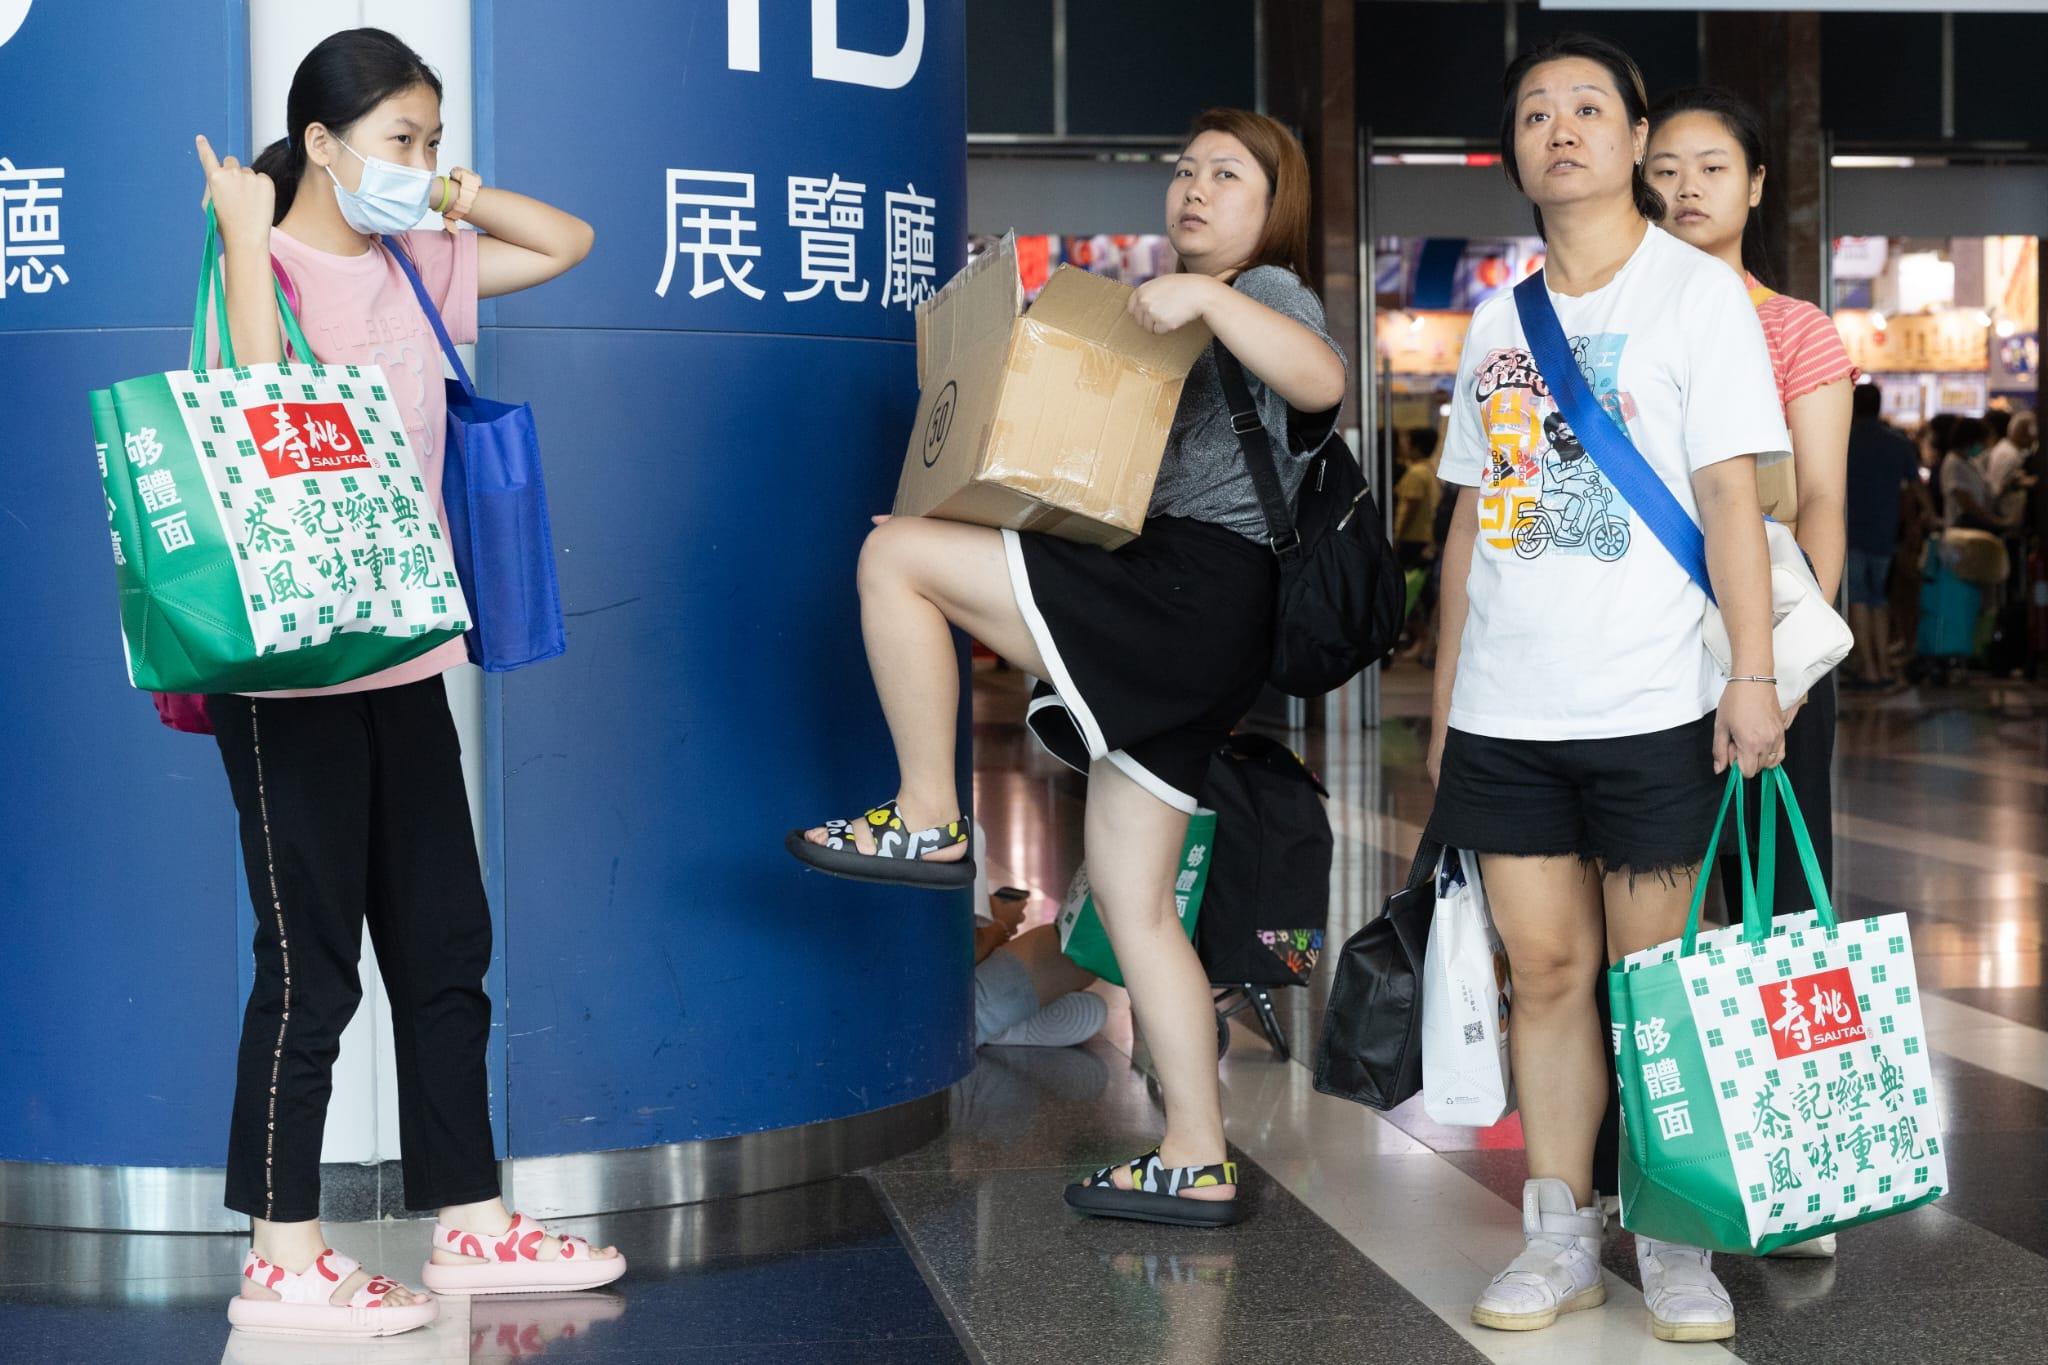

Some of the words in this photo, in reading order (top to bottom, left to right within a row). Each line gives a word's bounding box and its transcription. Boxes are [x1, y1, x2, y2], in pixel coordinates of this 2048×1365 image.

[654, 168, 937, 311] 展覽廳
[1491, 450, 1500, 487] adidas
[245, 485, 421, 552] 茶記經典
[260, 543, 441, 605] 風味重現
[1753, 1055, 1905, 1139] 茶記經典
[1765, 1116, 1924, 1195] 風味重現
